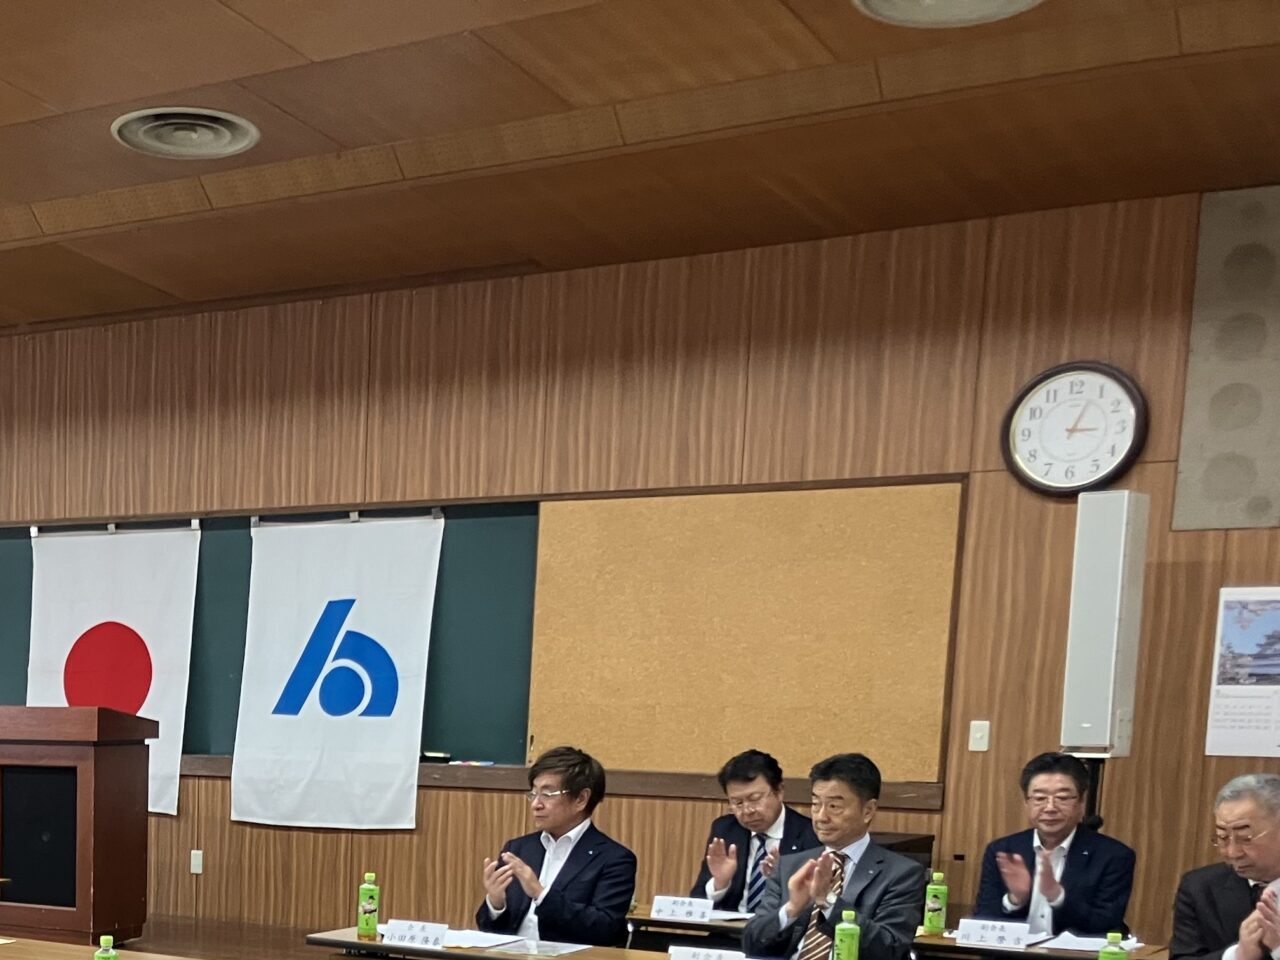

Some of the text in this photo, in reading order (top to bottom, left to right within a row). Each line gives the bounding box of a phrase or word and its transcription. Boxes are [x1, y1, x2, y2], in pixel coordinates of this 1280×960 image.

[1069, 379, 1086, 395] 12
[1098, 384, 1106, 399] 1
[1044, 389, 1058, 404] 11
[1029, 406, 1043, 421] 10
[1110, 399, 1122, 414] 2
[1021, 428, 1032, 442] 9
[1114, 420, 1127, 435] 3
[1027, 449, 1037, 463] 8
[1106, 443, 1117, 457] 4
[1043, 463, 1054, 477] 7
[1064, 465, 1075, 480] 6
[1089, 459, 1100, 473] 5
